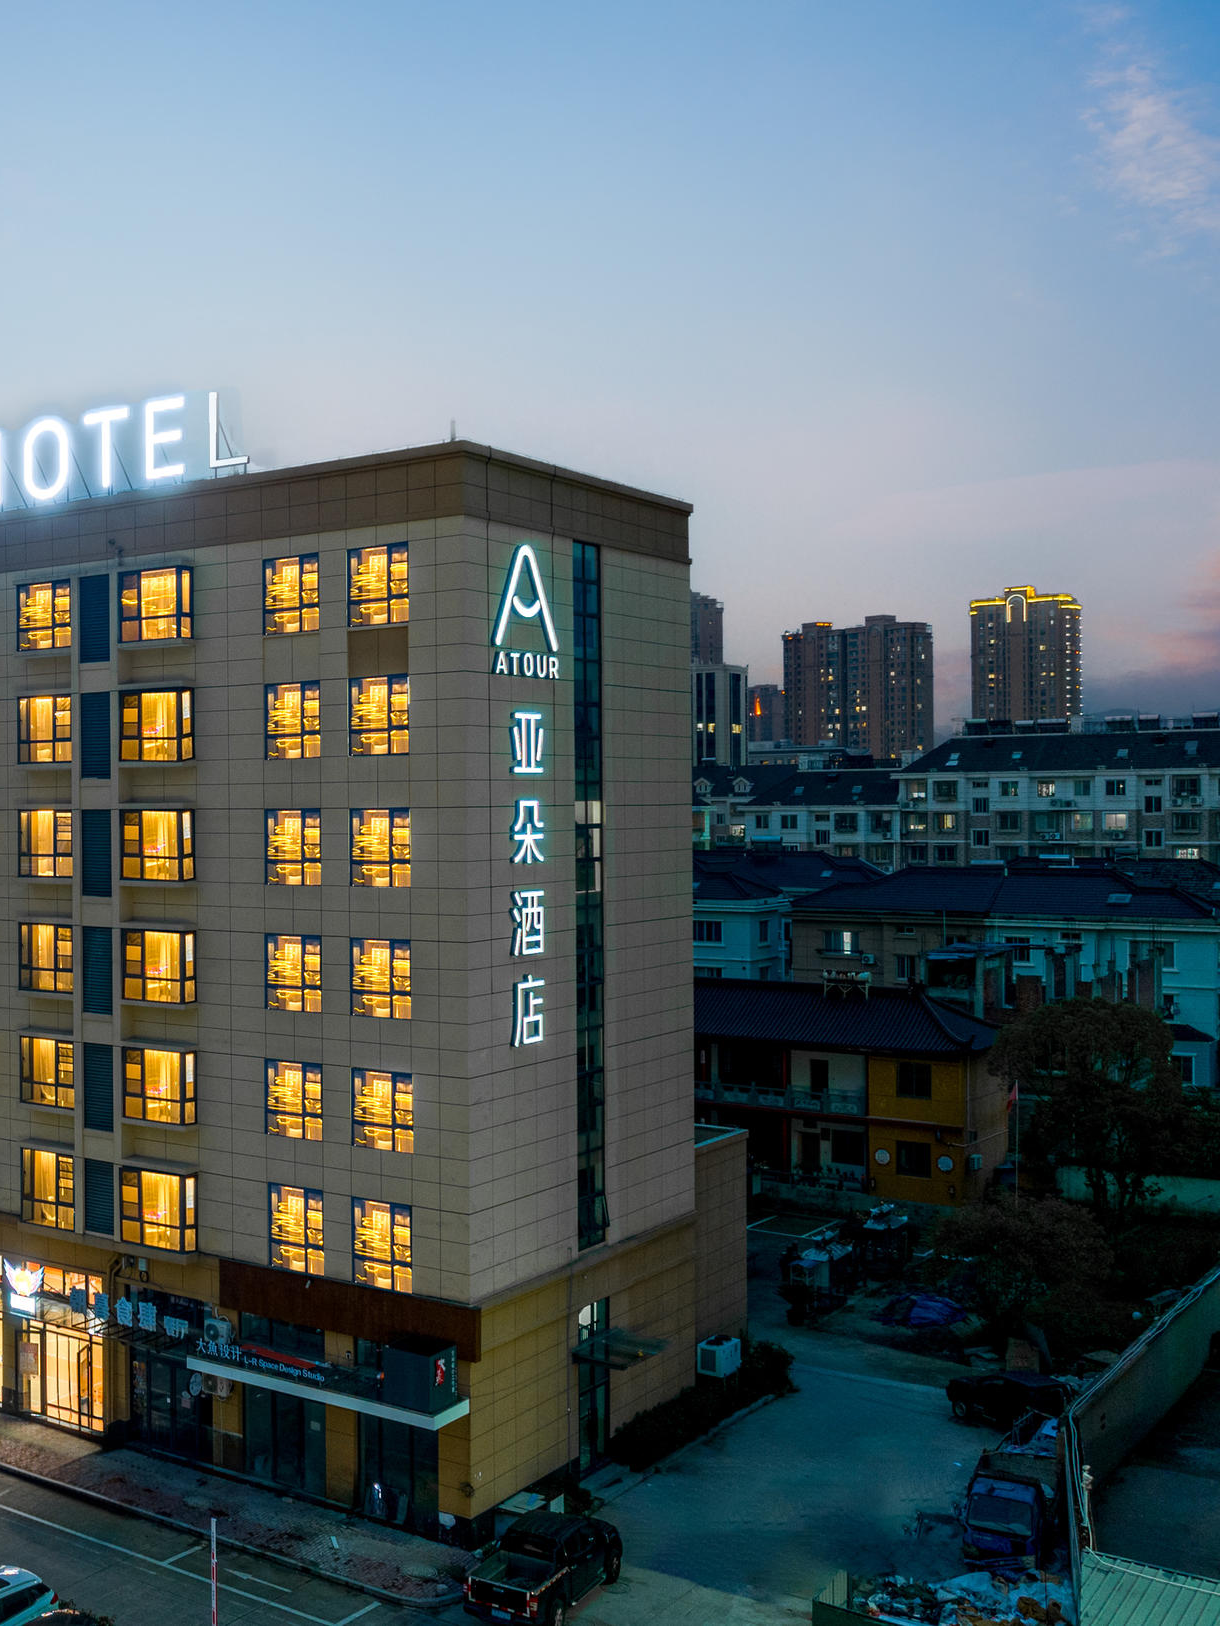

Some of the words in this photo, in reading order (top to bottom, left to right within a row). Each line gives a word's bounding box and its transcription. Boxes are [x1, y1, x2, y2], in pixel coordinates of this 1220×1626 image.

[494, 651, 560, 680] ATOUR
[510, 711, 546, 1047] 亚朵酒店
[258, 1359, 279, 1372] Space
[279, 1363, 302, 1377] Design
[302, 1367, 326, 1383] Studio
